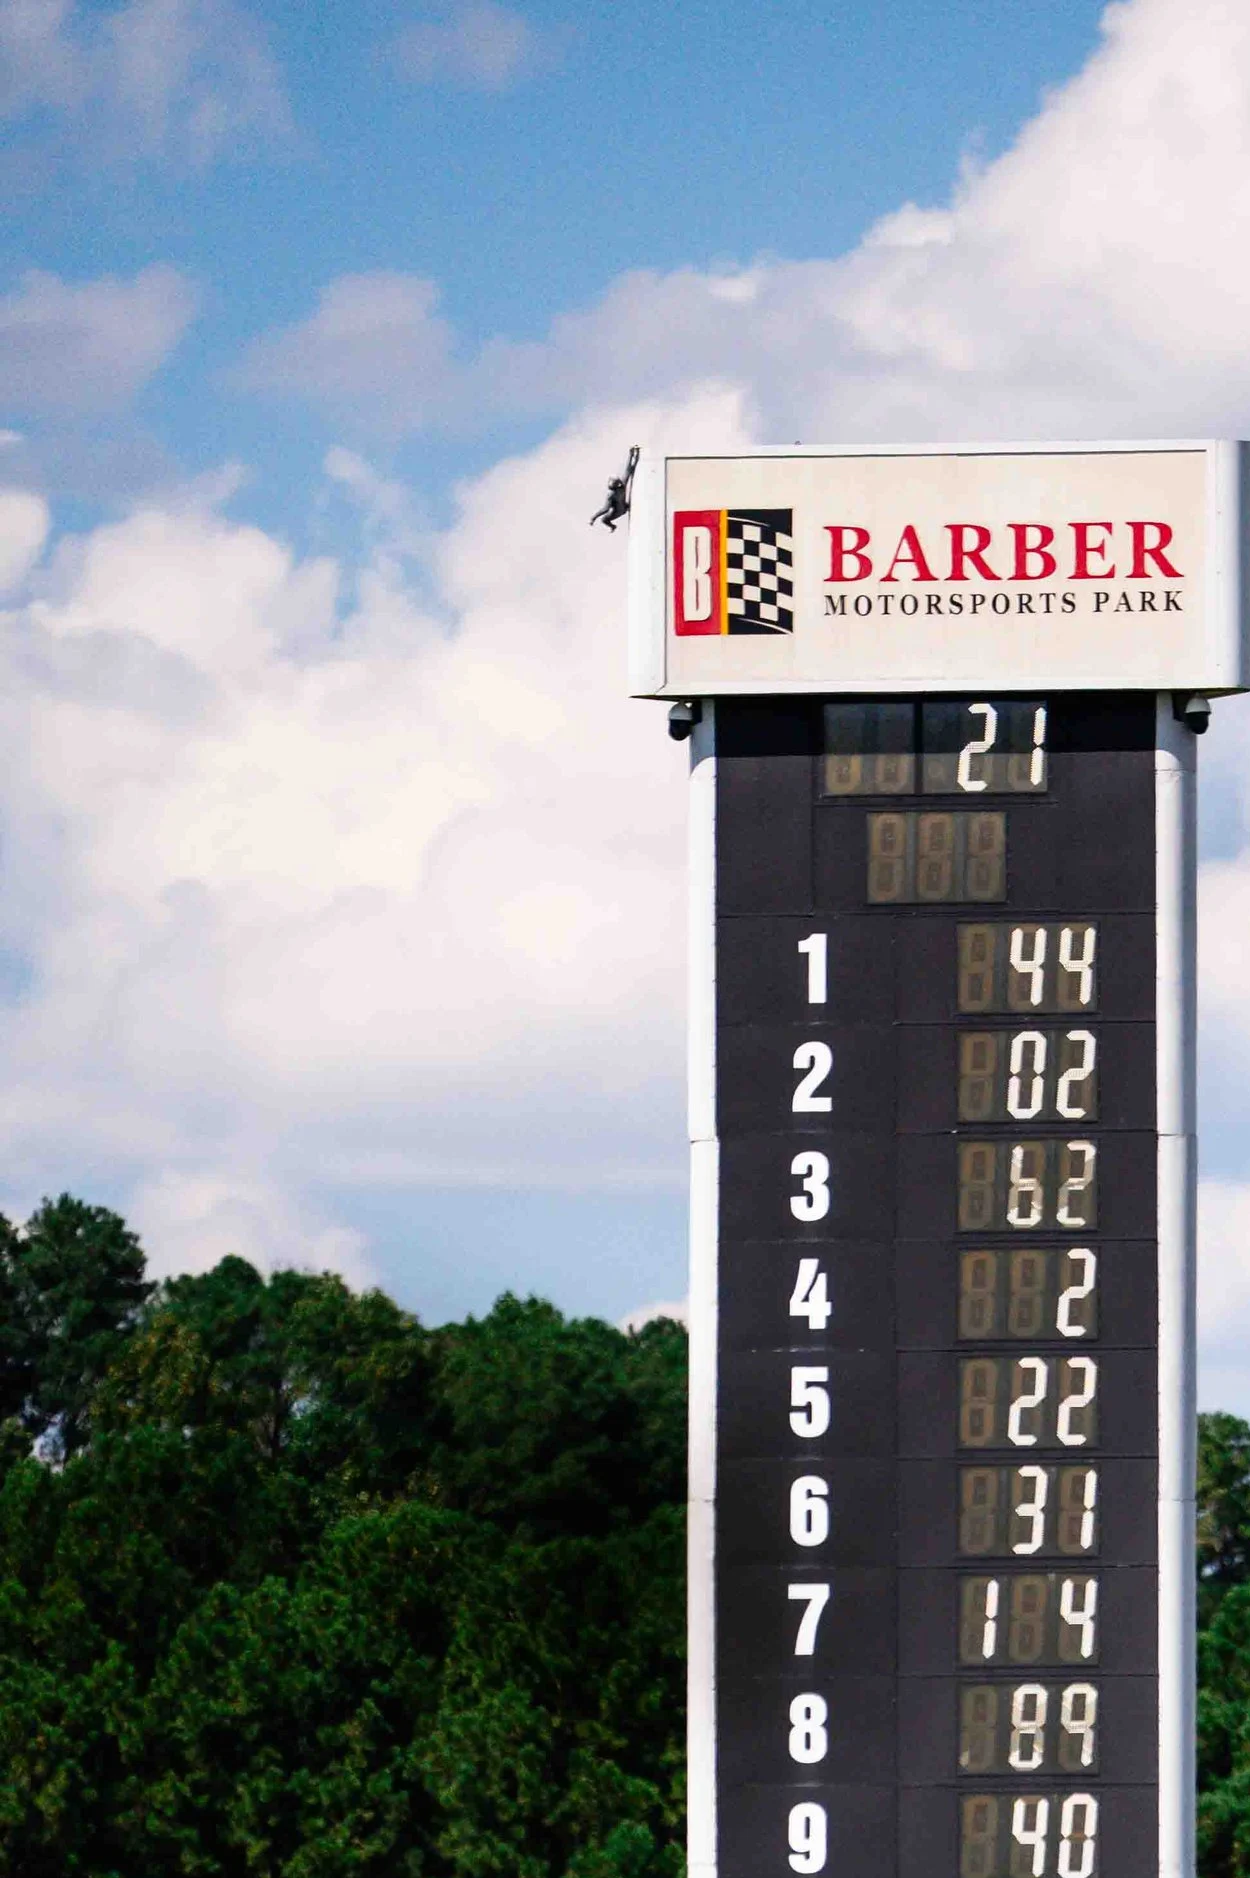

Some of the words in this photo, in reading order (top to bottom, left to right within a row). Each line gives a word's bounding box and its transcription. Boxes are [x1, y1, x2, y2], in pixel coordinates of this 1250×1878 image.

[824, 521, 1184, 583] BARBER
[824, 592, 1077, 617] MOTORSPORTS
[1092, 590, 1183, 613] PARK
[958, 704, 1046, 791] 21
[798, 934, 826, 1003] 1
[1010, 928, 1095, 1005] 44
[792, 1042, 832, 1112] 2
[1007, 1030, 1096, 1119] 02
[791, 1152, 829, 1221] 3
[1007, 1142, 1095, 1226] 62
[790, 1259, 831, 1329] 4
[1056, 1249, 1096, 1336] 2
[790, 1367, 829, 1437] 5
[1008, 1357, 1097, 1445] 22
[790, 1476, 828, 1546] 6
[1013, 1466, 1097, 1554] 31
[788, 1584, 829, 1655] 7
[789, 1694, 827, 1763] 8
[1009, 1684, 1097, 1770] 89
[789, 1802, 826, 1873] 9
